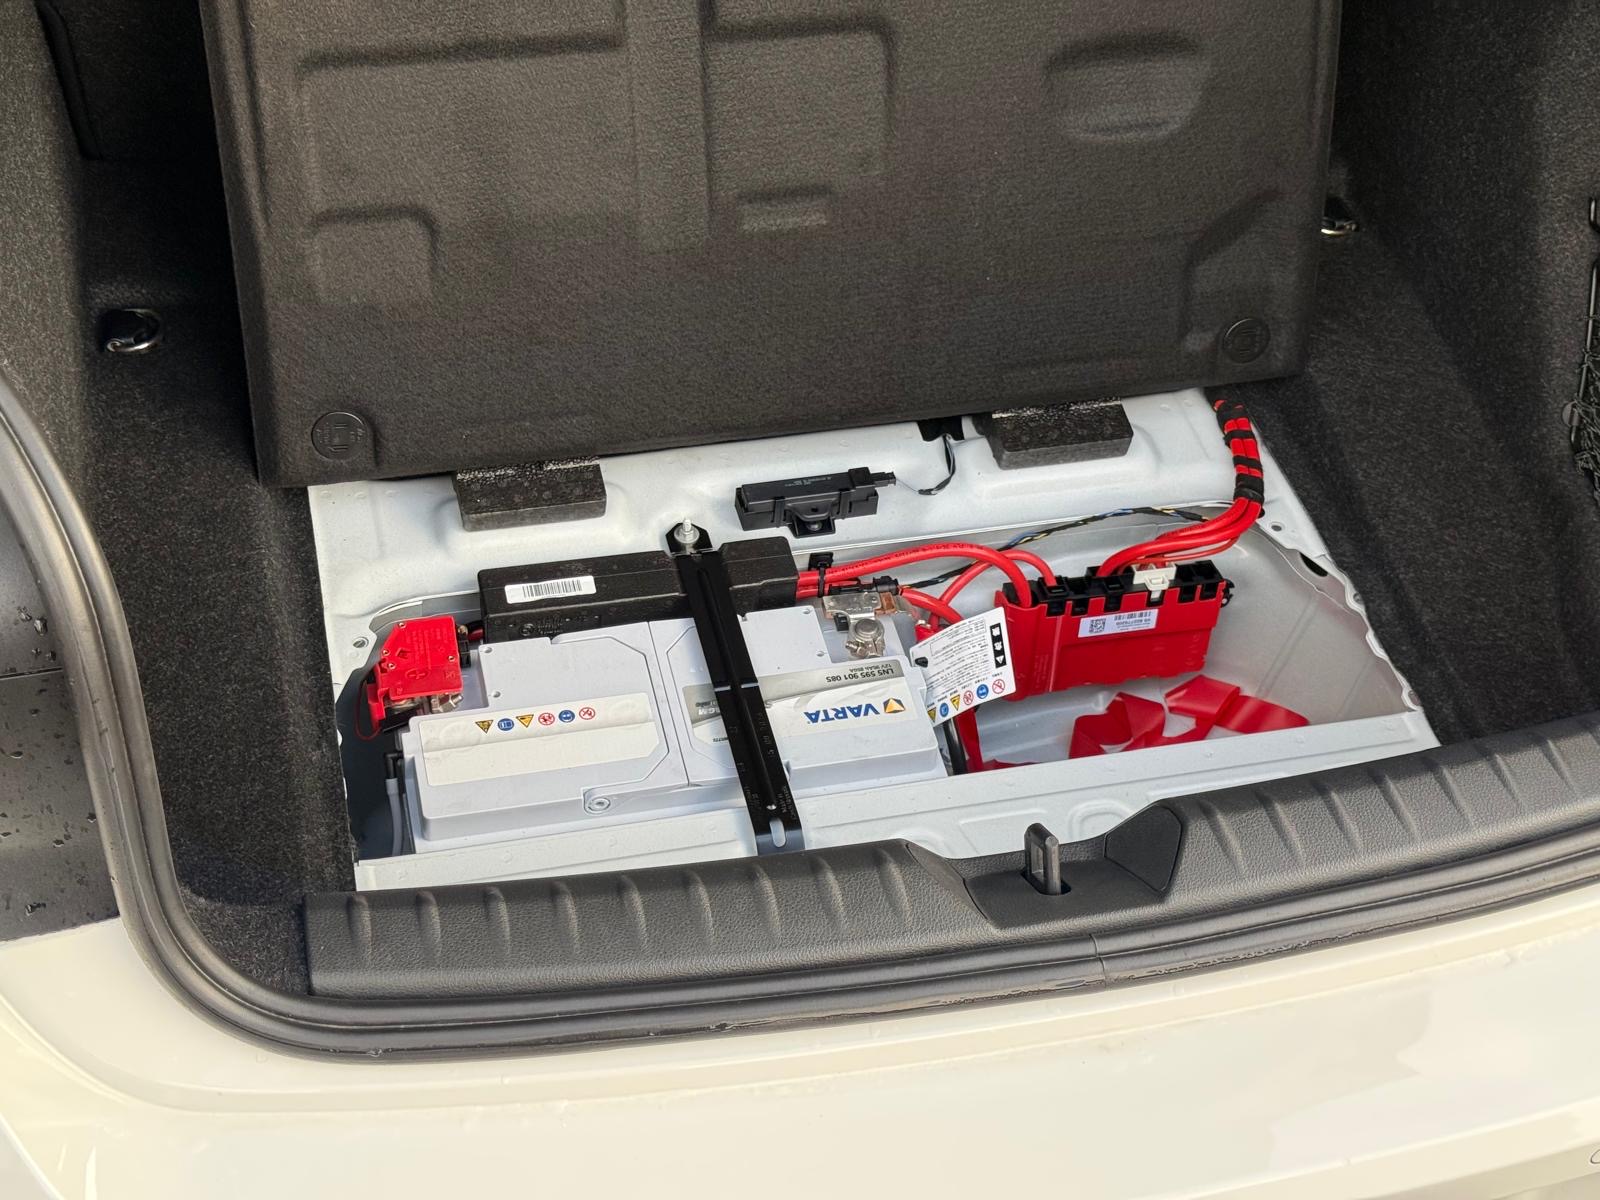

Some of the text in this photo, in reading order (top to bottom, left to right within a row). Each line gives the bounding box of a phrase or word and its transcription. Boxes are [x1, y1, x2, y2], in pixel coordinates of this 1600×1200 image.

[825, 675, 842, 683] 085
[861, 670, 876, 679] 595
[804, 703, 880, 724] VARTA
